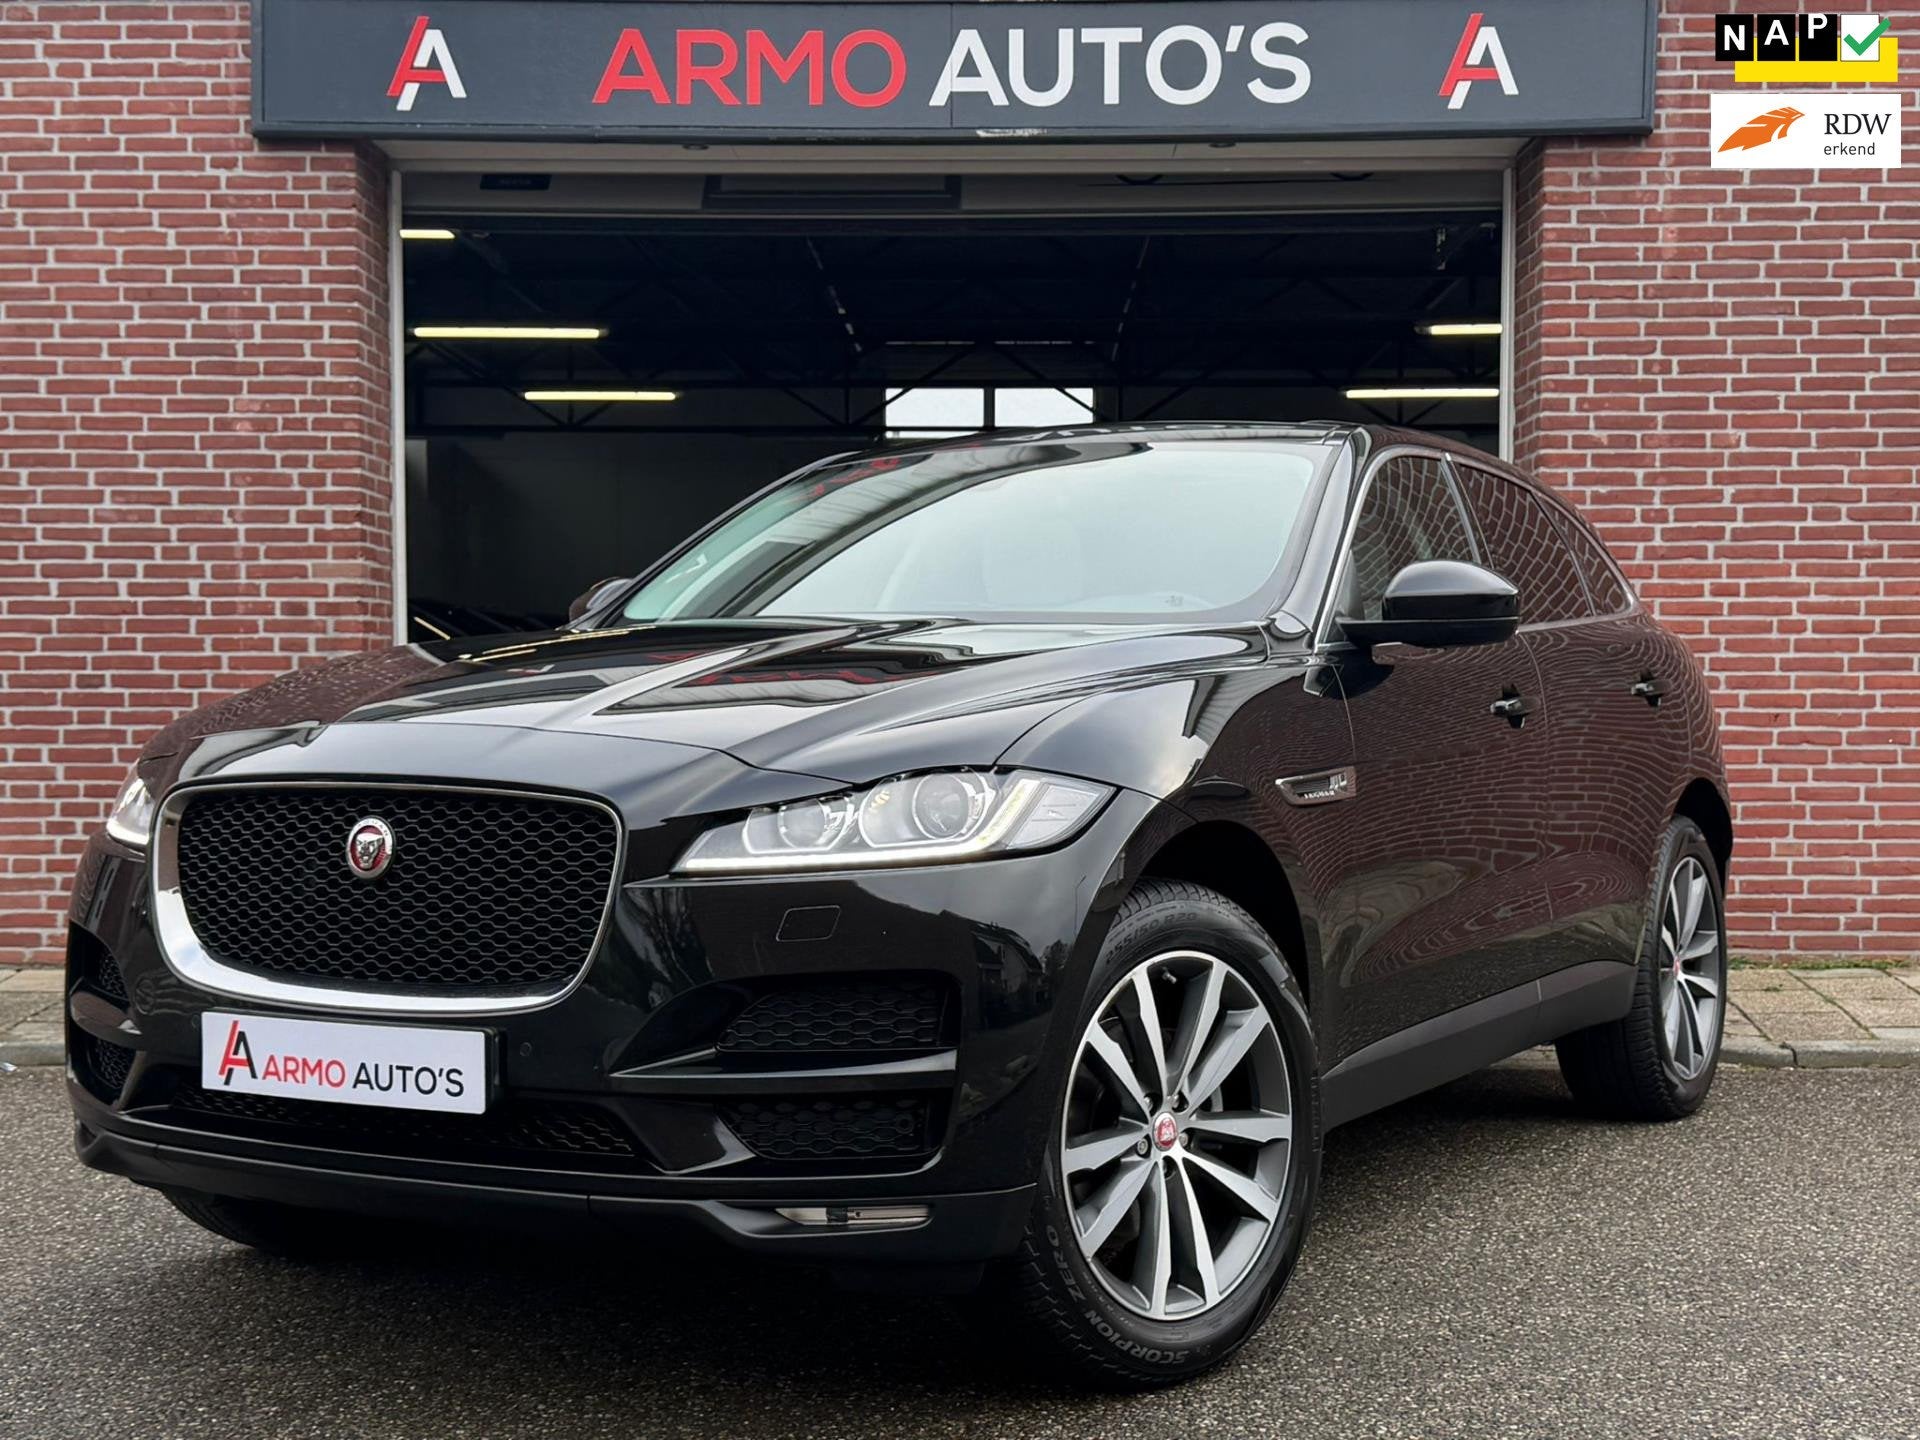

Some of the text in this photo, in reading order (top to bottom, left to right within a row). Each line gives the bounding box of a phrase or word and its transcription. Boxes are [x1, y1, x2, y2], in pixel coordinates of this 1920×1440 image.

[592, 22, 1312, 107] ARMO AUTO'S
[262, 1054, 465, 1097] ARMO AUTO'S
[1046, 1225, 1086, 1302] ZERO
[1084, 1310, 1190, 1364] SCORPION
